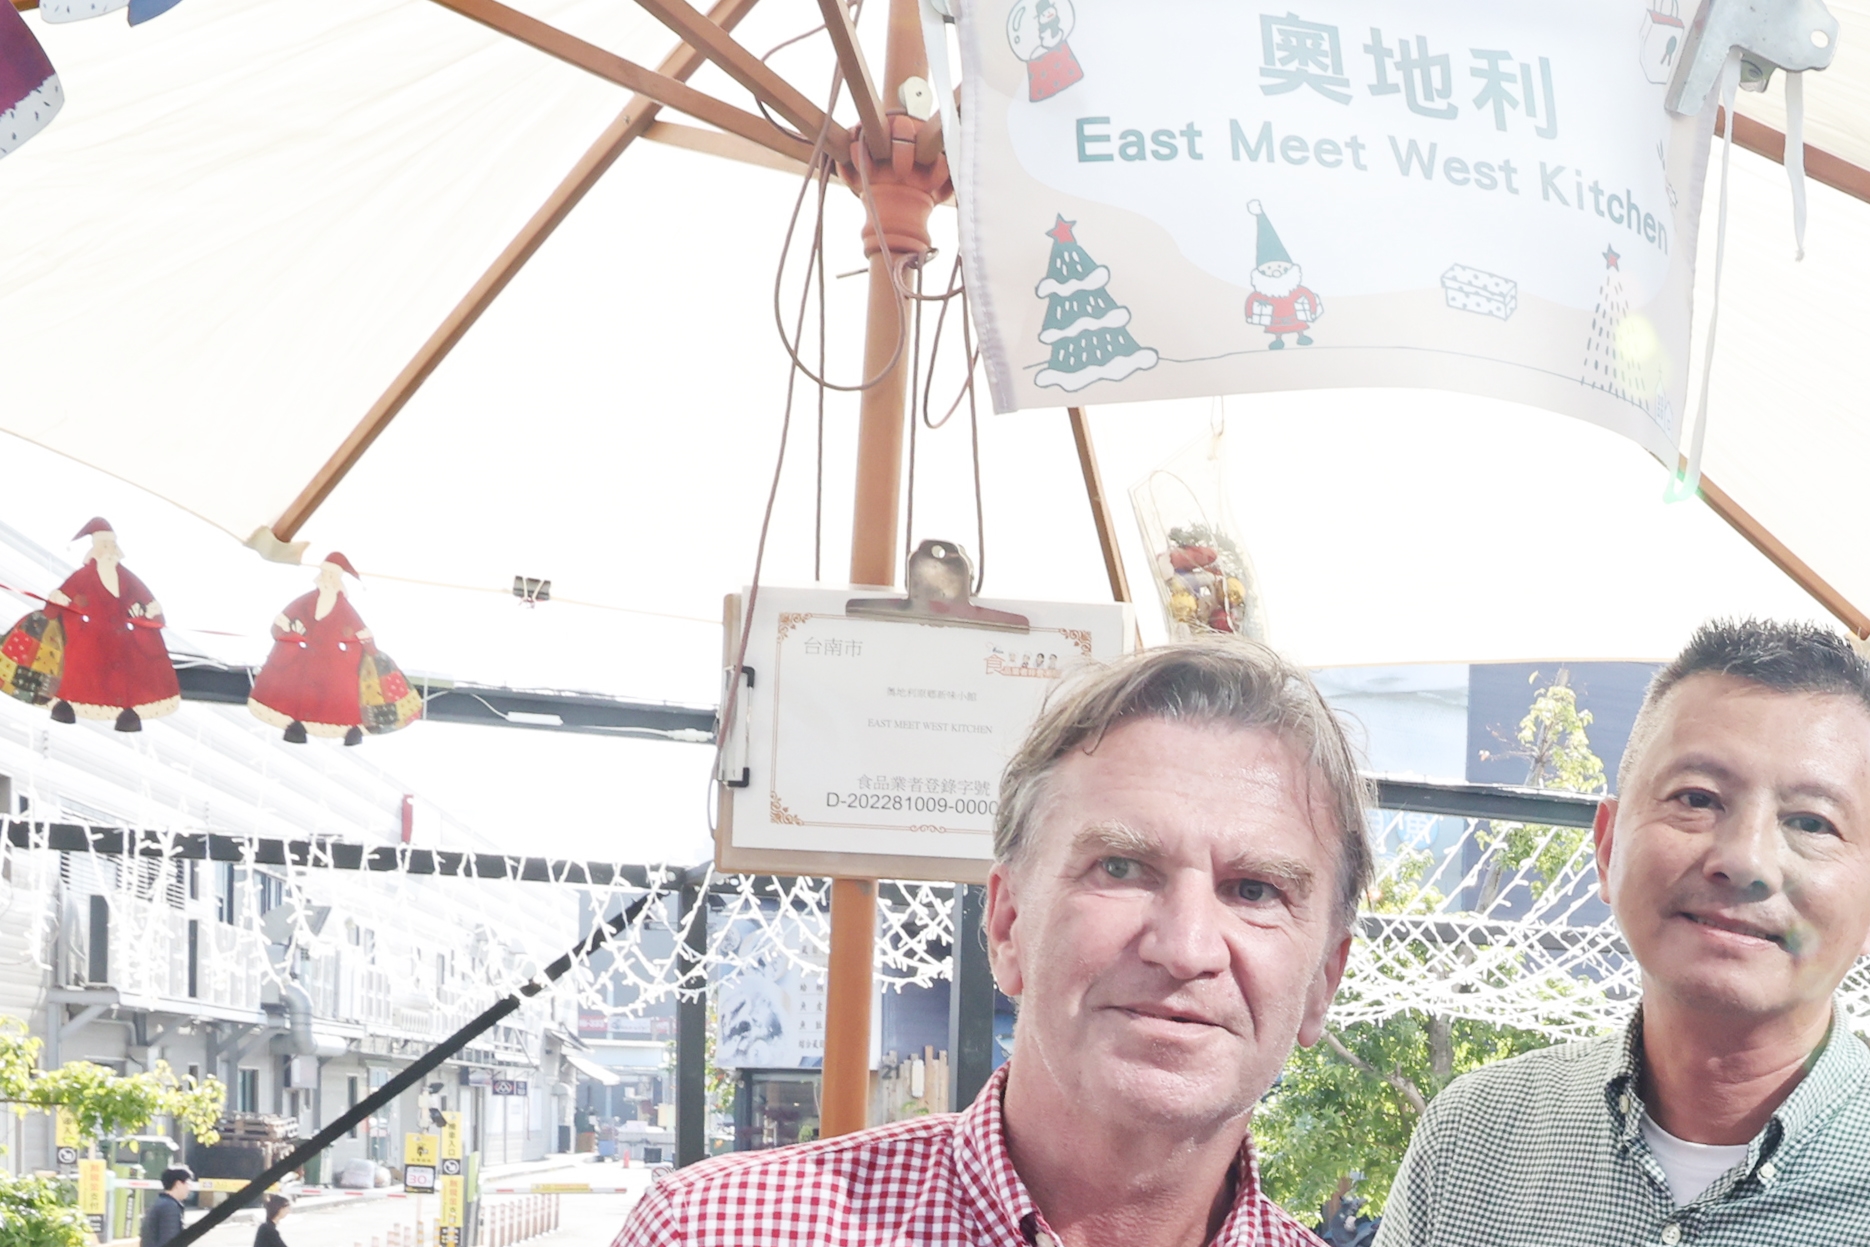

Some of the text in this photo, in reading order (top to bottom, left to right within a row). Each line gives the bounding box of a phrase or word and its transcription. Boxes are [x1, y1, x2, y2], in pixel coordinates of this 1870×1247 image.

[1257, 11, 1560, 141] 奧地利
[1075, 116, 1669, 256] East Meet West Kitchen
[803, 636, 863, 658] 台南市
[868, 718, 993, 735] EAST MEET WEST KITCHEN
[857, 773, 991, 797] 食品業者登錄字號
